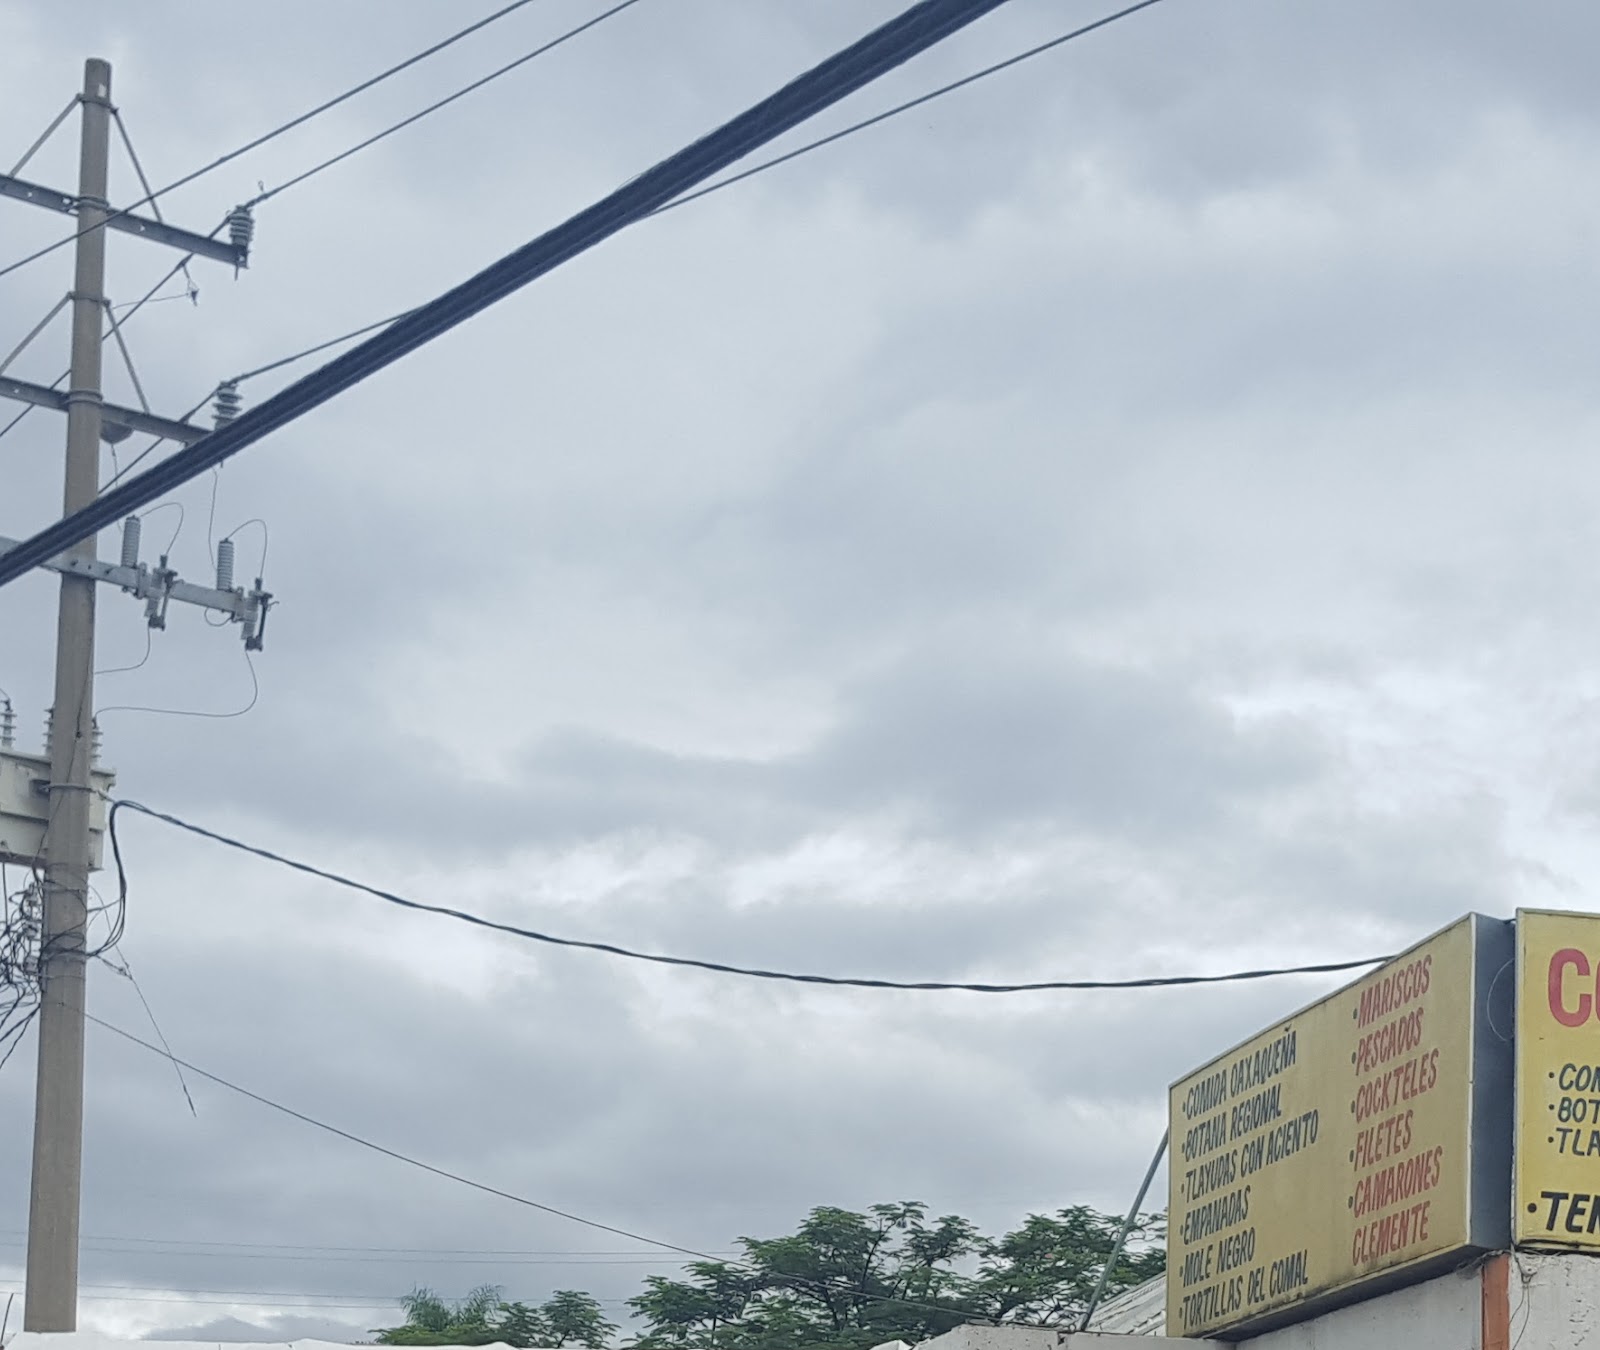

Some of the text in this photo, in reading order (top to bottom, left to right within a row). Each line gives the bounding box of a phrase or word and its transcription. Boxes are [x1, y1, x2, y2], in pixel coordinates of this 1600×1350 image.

[1358, 954, 1432, 1028] MARISCOS
[1186, 1024, 1297, 1120] COMIDA OAXAQUEÑA
[1356, 1007, 1424, 1076] PESCADOS
[1185, 1083, 1282, 1162] BOTANA REGIONAL
[1355, 1048, 1439, 1124] COCKTELES
[1186, 1109, 1319, 1203] TLAYUDAS CON ACIENTO
[1354, 1109, 1413, 1172] FILETES
[1184, 1185, 1251, 1245] EMPANADAS
[1353, 1146, 1442, 1218] CAMARONES
[1183, 1227, 1255, 1288] MOLE NEGRO
[1352, 1200, 1431, 1266] CLEMENTE
[1183, 1249, 1308, 1330] TORTILLAS DEL COMAL
